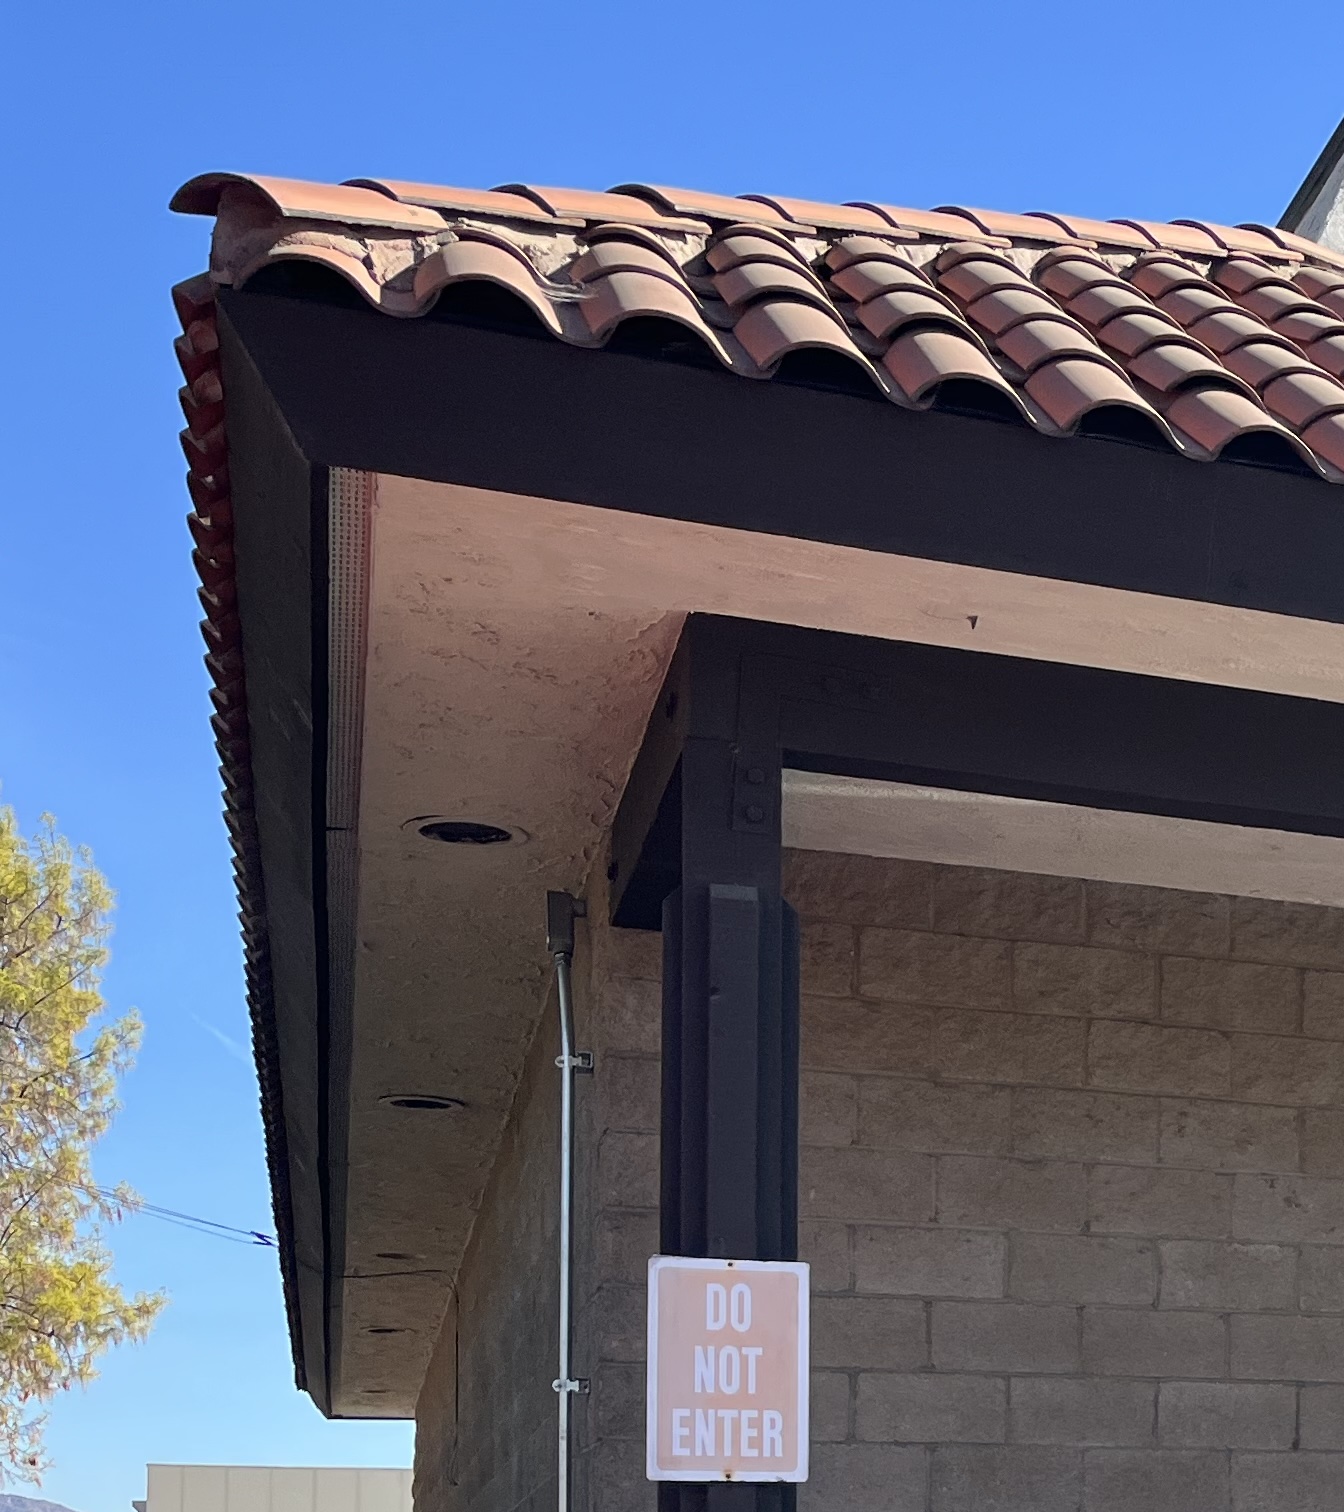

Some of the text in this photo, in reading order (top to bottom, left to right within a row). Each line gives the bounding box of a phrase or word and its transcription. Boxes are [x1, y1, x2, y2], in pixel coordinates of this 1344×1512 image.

[706, 1283, 752, 1332] DO
[694, 1345, 763, 1394] NOT
[672, 1408, 783, 1458] ENTER
